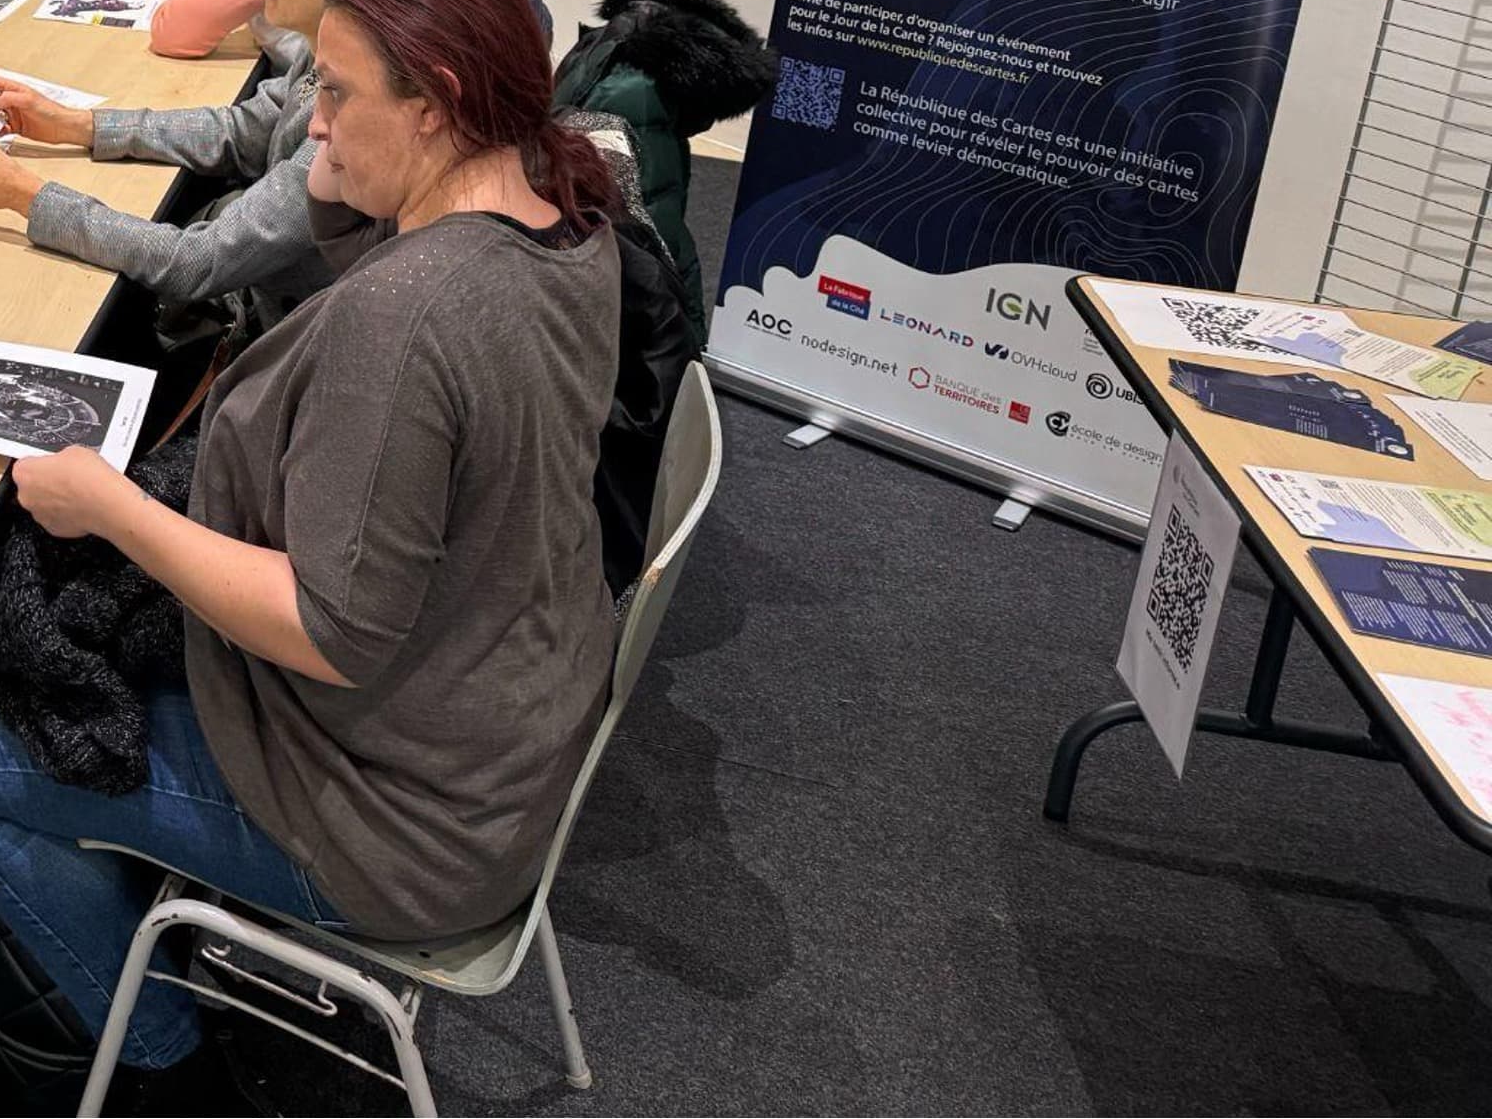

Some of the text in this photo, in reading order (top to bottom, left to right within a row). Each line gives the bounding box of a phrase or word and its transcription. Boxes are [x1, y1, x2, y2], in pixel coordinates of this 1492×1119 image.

[787, 18, 1030, 84] les infos sur www.republiquedescartes.fr
[789, 5, 1103, 86] pour le Jour de la Carte ? Rejoignez-nous et trouvez
[843, 1, 904, 24] participer,
[977, 30, 994, 44] un
[997, 34, 1071, 62] événement
[860, 81, 1195, 180] La République des Cartes est une initiative
[853, 121, 1072, 189] comme levier démocratique.
[856, 102, 1199, 203] collective pour révéler le pouvoir des cartes
[746, 309, 792, 335] AOC
[880, 308, 974, 348] LEONARD
[985, 287, 1052, 331] IGN
[801, 334, 899, 377] nodesign.net
[1011, 351, 1078, 382] OVHcloud
[933, 384, 1000, 415] TERRITOIRES
[935, 374, 980, 397] BANQUE
[1070, 424, 1103, 442] école
[1105, 435, 1121, 448] de
[1123, 442, 1163, 462] design
